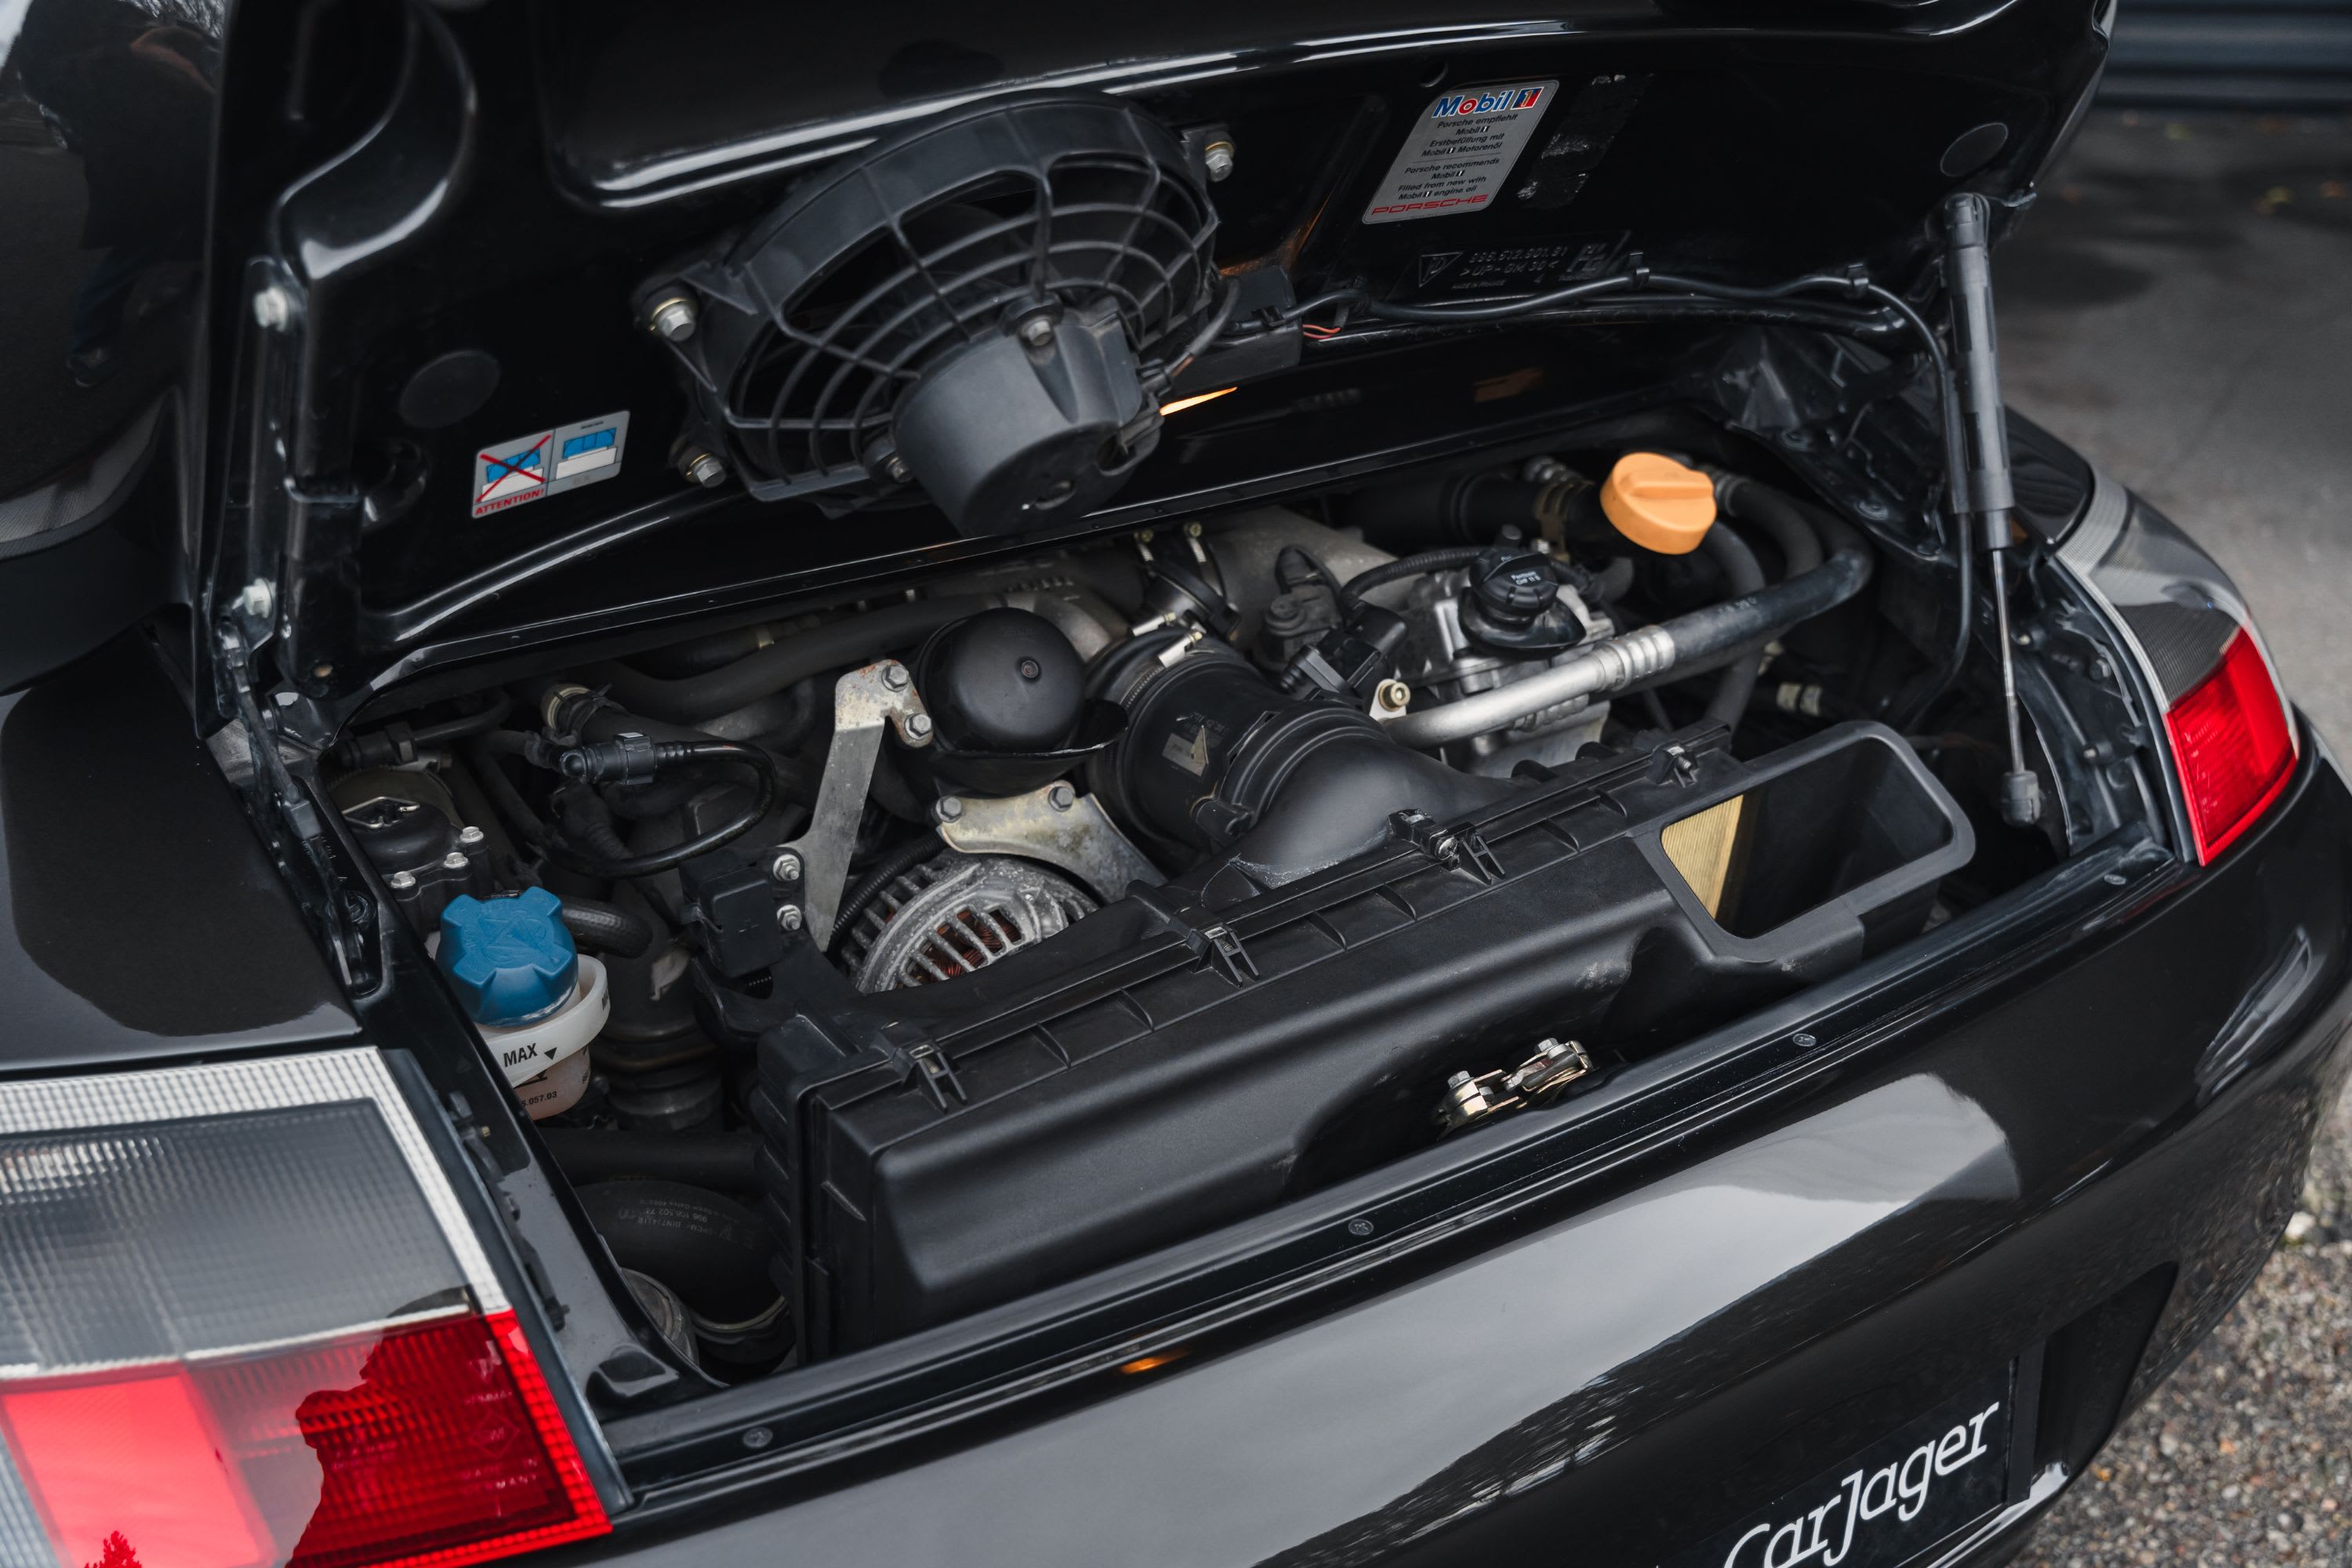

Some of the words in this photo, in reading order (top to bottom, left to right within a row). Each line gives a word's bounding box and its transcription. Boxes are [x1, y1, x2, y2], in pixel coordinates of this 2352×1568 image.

[1432, 90, 1515, 118] Mobil
[1436, 118, 1474, 129] Porsche
[1475, 114, 1519, 125] empfiehlt
[1455, 126, 1481, 136] Mobil
[1429, 136, 1487, 147] Erstbefüllung
[1421, 148, 1446, 158] Mobil
[1457, 142, 1503, 154] Motorenöl
[1404, 165, 1441, 175] Porsche
[1443, 158, 1501, 169] recommends
[1431, 172, 1456, 180] Mobil
[1398, 182, 1422, 192] Filled
[1424, 181, 1445, 190] from
[1398, 192, 1423, 201] Mobil
[1433, 189, 1464, 198] engine
[1372, 194, 1489, 215] PORSCHE
[476, 488, 544, 516] ATTENTION!
[503, 1043, 539, 1068] MAX
[1724, 1401, 1999, 1568] CarJager
